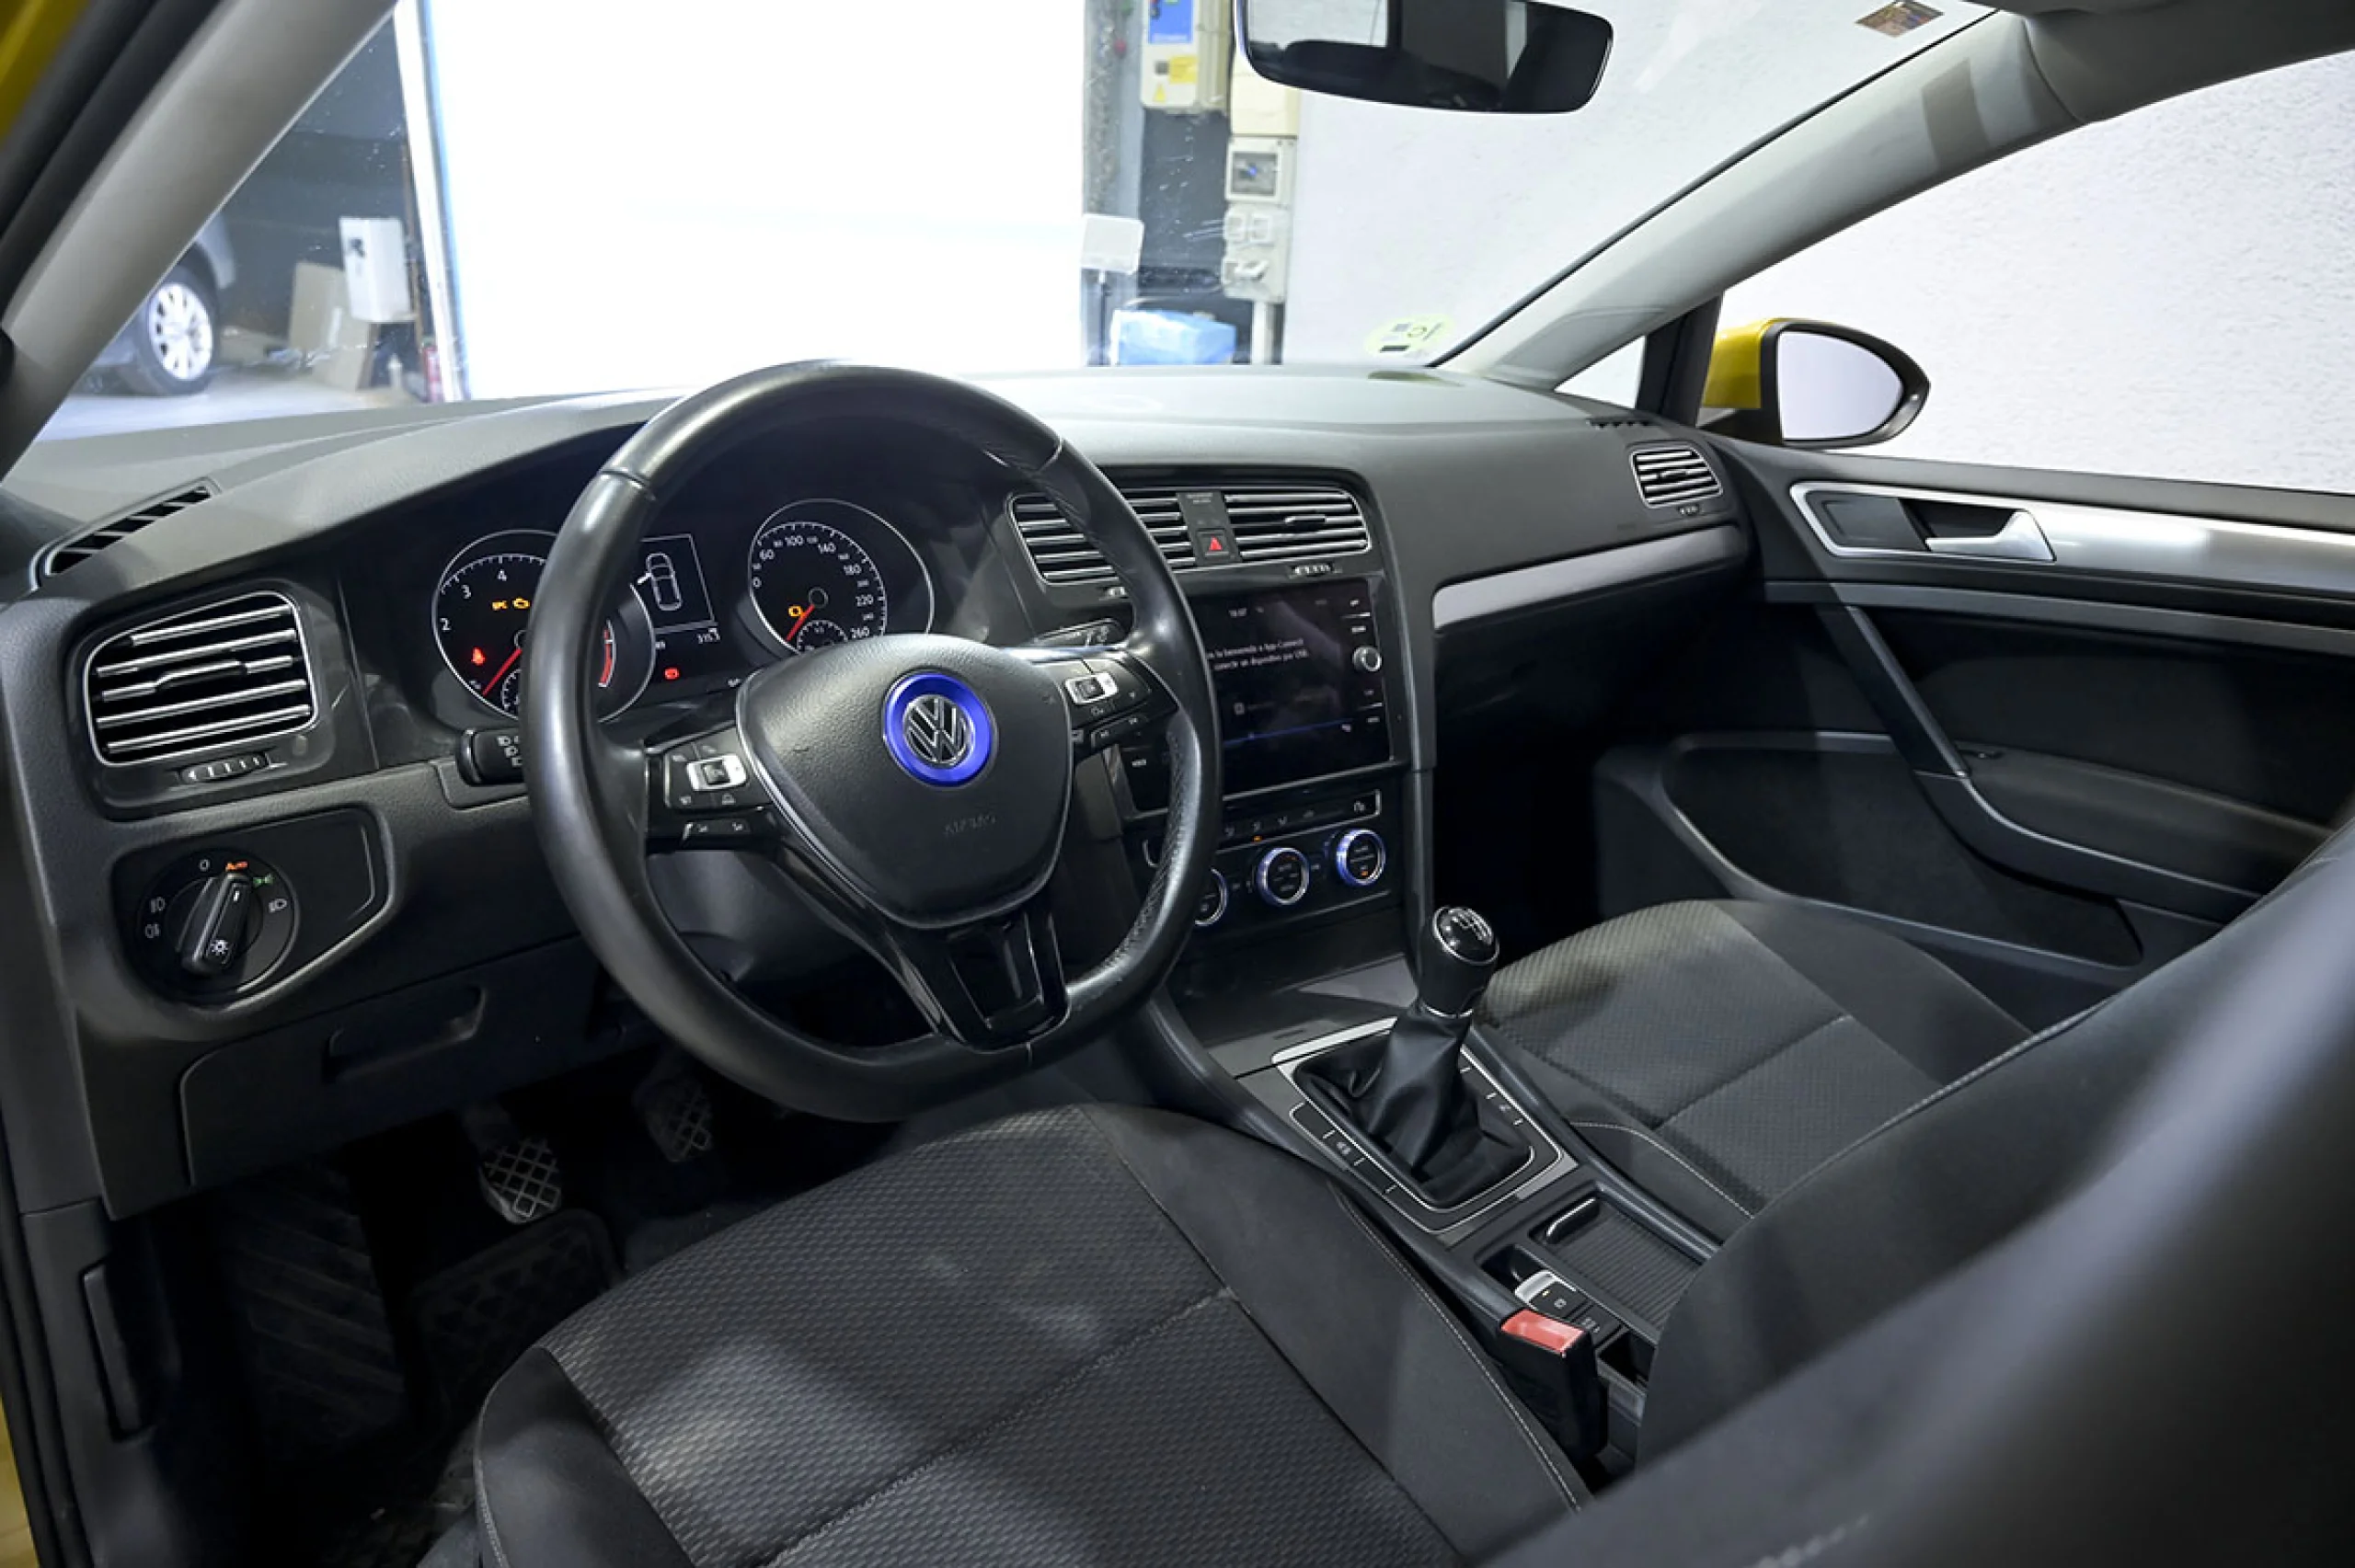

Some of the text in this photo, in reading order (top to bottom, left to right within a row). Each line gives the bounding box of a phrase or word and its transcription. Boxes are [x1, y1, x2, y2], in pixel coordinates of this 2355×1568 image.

[498, 569, 507, 581] 4
[462, 584, 472, 599] 3
[440, 617, 452, 631] 2
